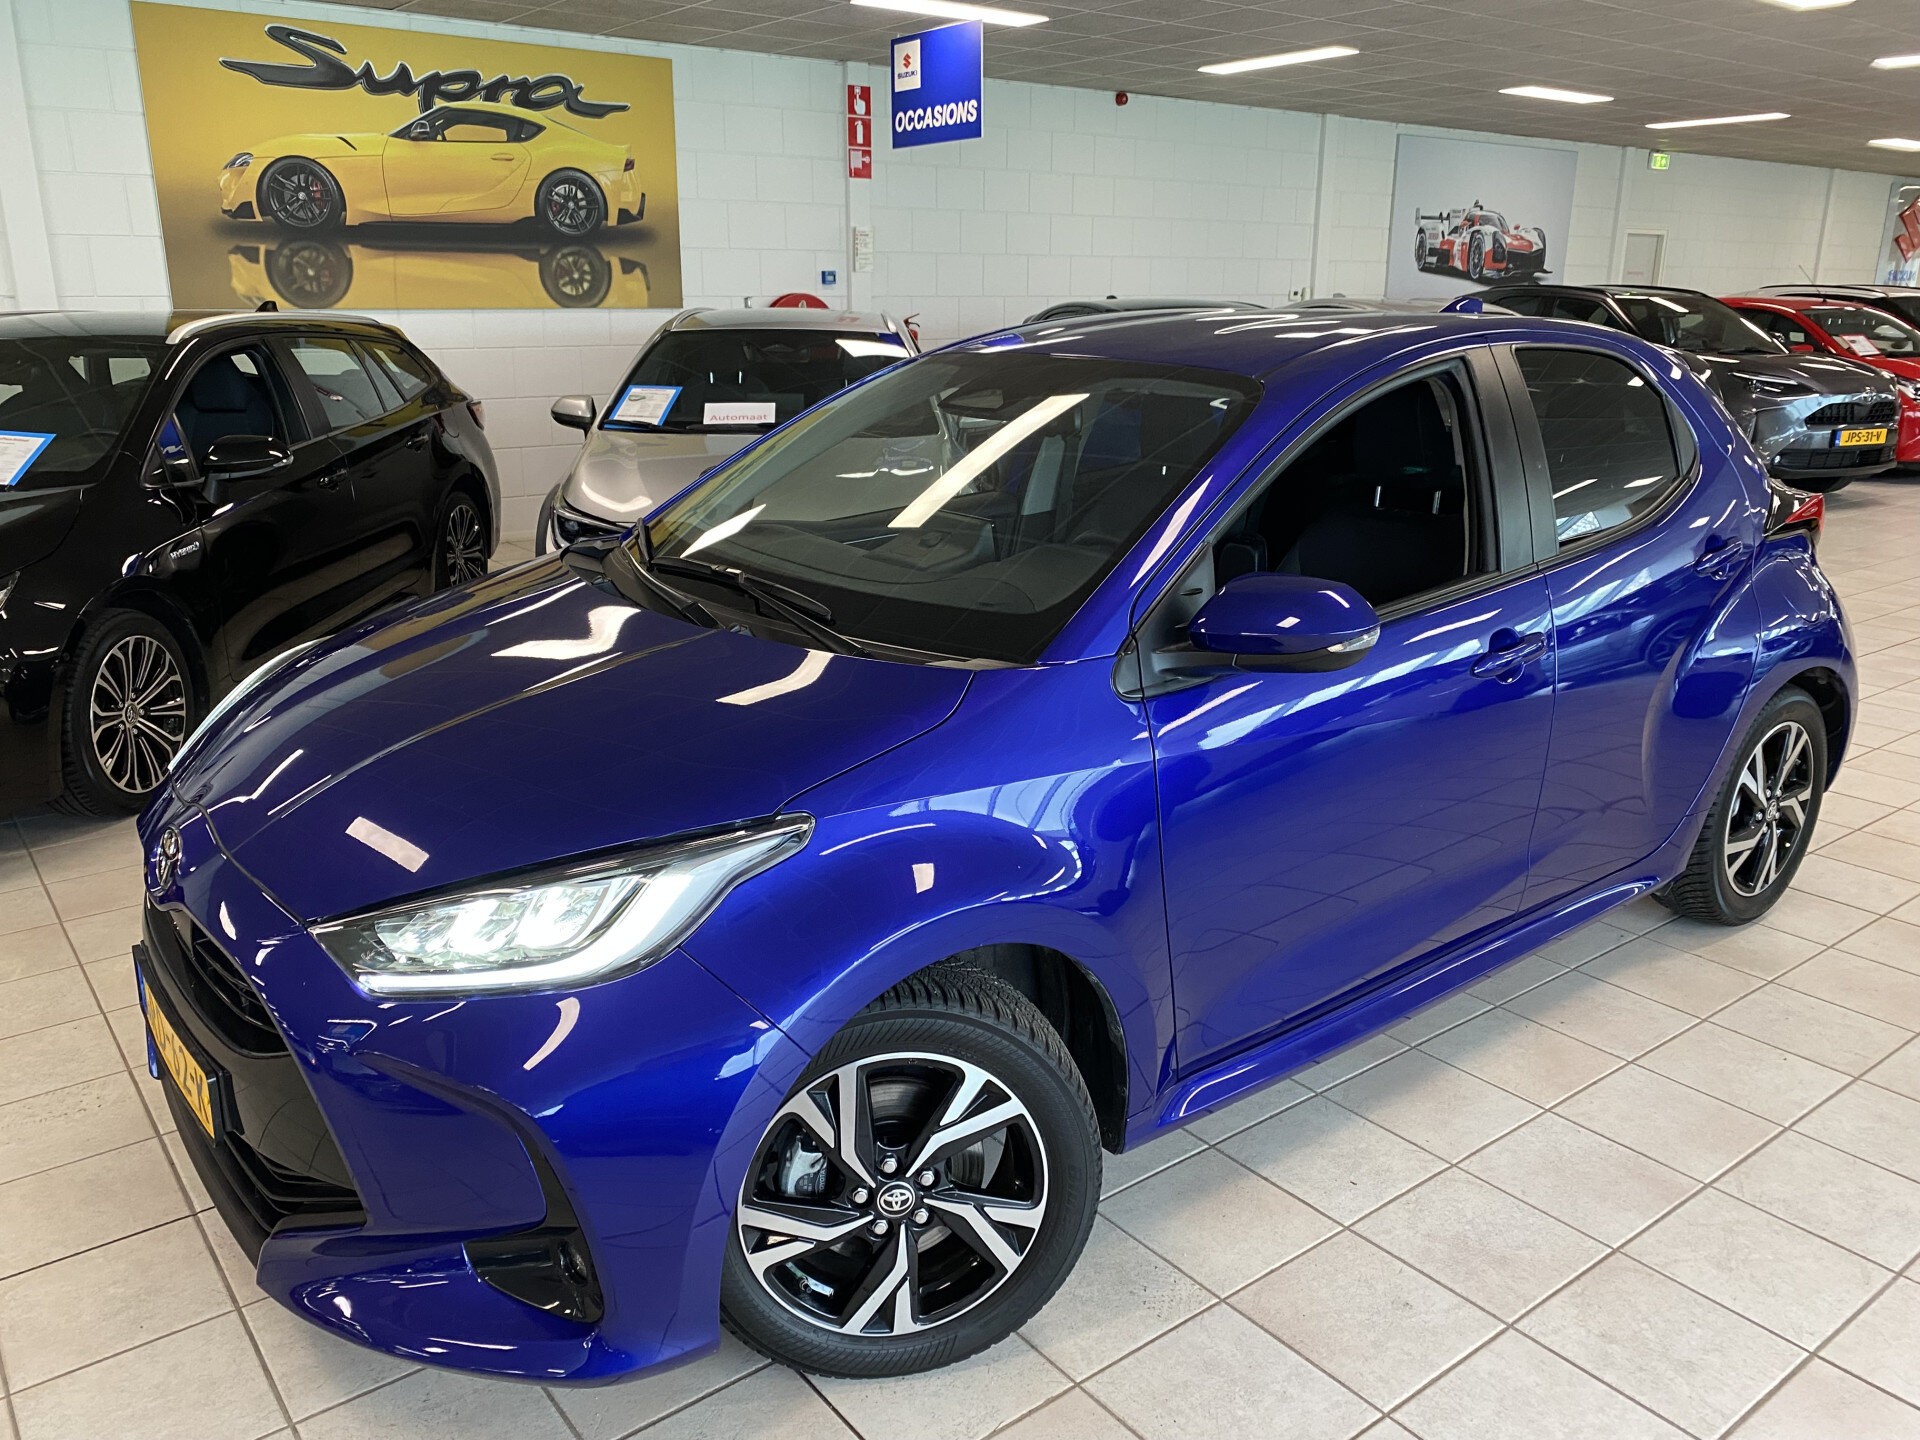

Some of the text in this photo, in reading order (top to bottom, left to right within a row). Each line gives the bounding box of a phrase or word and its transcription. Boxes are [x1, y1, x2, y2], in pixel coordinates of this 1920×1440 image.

[219, 23, 631, 119] Supra
[897, 70, 918, 80] SUZUKI
[895, 99, 978, 133] OCCASIONS
[709, 413, 768, 422] Automaat
[1845, 431, 1882, 443] JPS-31-V
[169, 541, 200, 559] HYBRID
